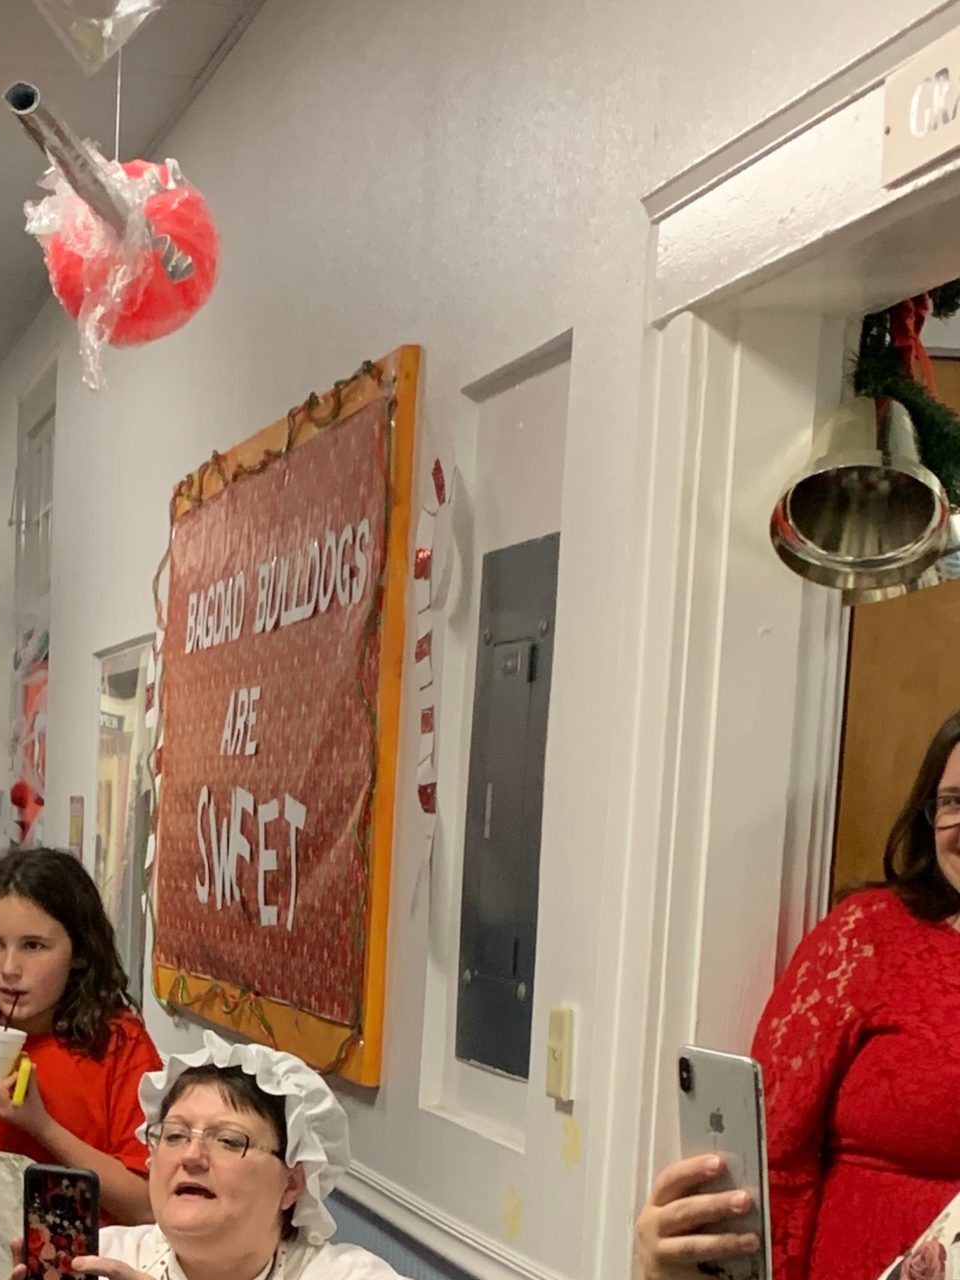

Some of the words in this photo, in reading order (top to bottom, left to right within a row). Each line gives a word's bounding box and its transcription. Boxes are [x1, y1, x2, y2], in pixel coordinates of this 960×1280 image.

[185, 571, 246, 654] BAGDAD
[255, 518, 372, 634] BULLDOGS
[220, 686, 261, 755] ARE
[195, 785, 307, 932] SWEET
